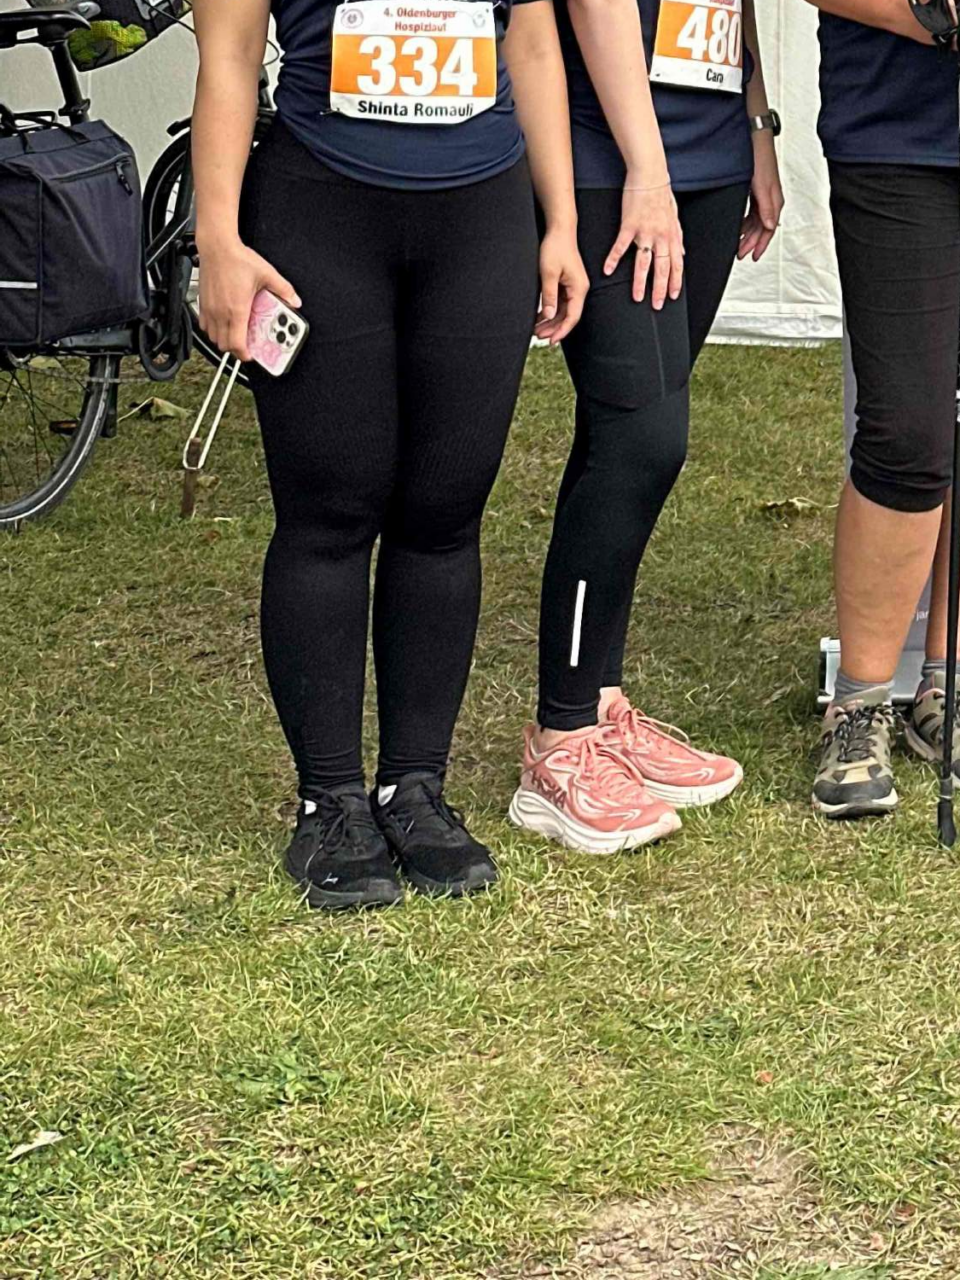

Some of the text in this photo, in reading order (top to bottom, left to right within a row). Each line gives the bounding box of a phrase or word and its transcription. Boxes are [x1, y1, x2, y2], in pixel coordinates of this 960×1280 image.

[396, 7, 458, 20] Oldenburger
[676, 6, 742, 67] 480
[357, 35, 478, 97] 334
[357, 100, 475, 118] Shinta Romauli
